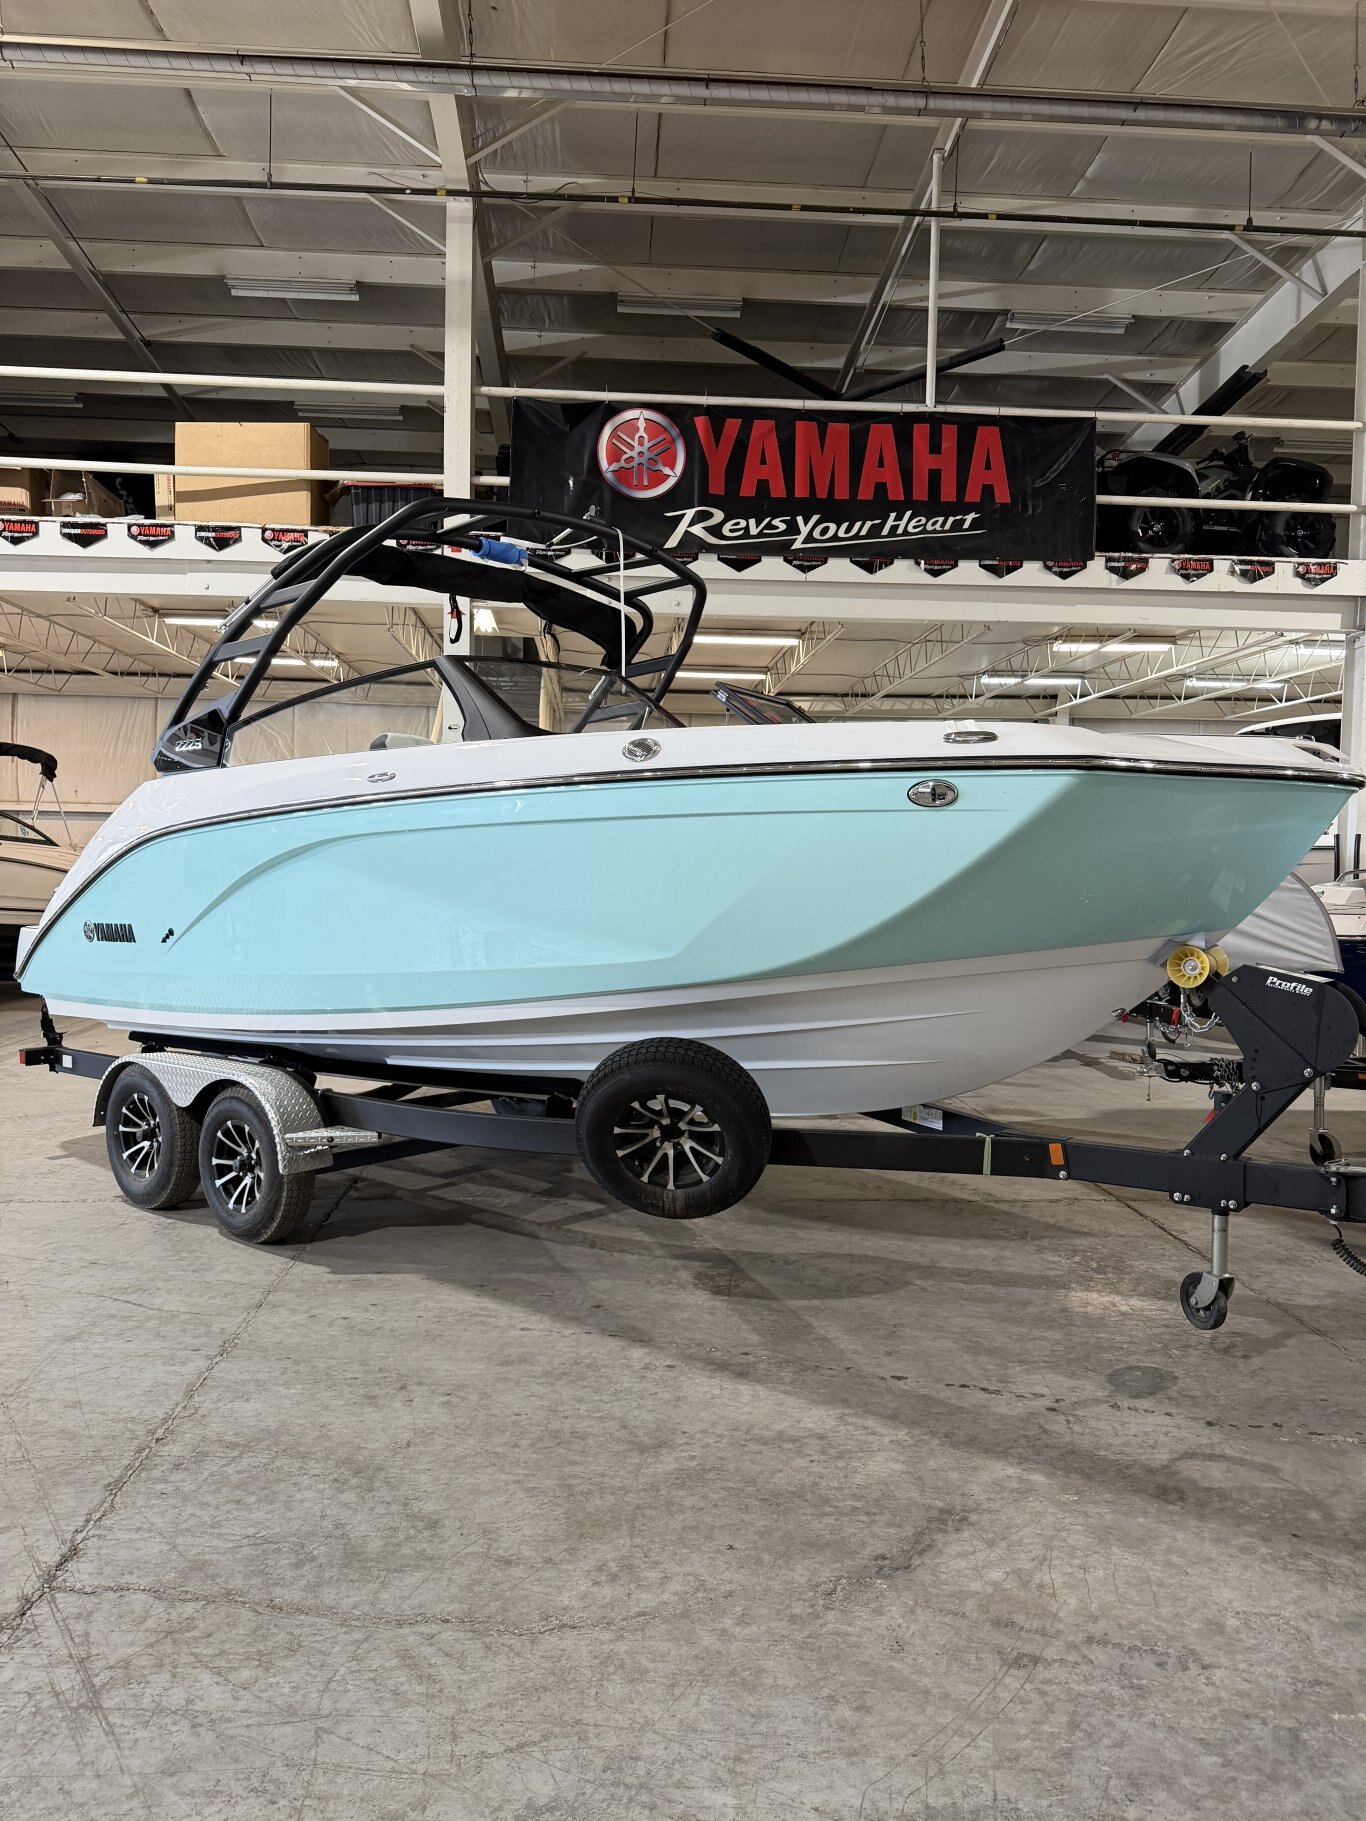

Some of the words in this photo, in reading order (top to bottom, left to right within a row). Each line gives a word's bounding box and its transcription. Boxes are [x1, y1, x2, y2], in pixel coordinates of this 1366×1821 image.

[693, 415, 1011, 504] YAMAHA
[4, 522, 36, 533] YAMAHA
[141, 527, 171, 536] YAMAHA
[663, 507, 792, 549] Revs
[791, 515, 888, 550] Your
[886, 510, 988, 538] Heart
[1182, 560, 1211, 570] YAMAHA
[93, 922, 136, 943] YAMAHA
[1266, 976, 1313, 994] Profile
